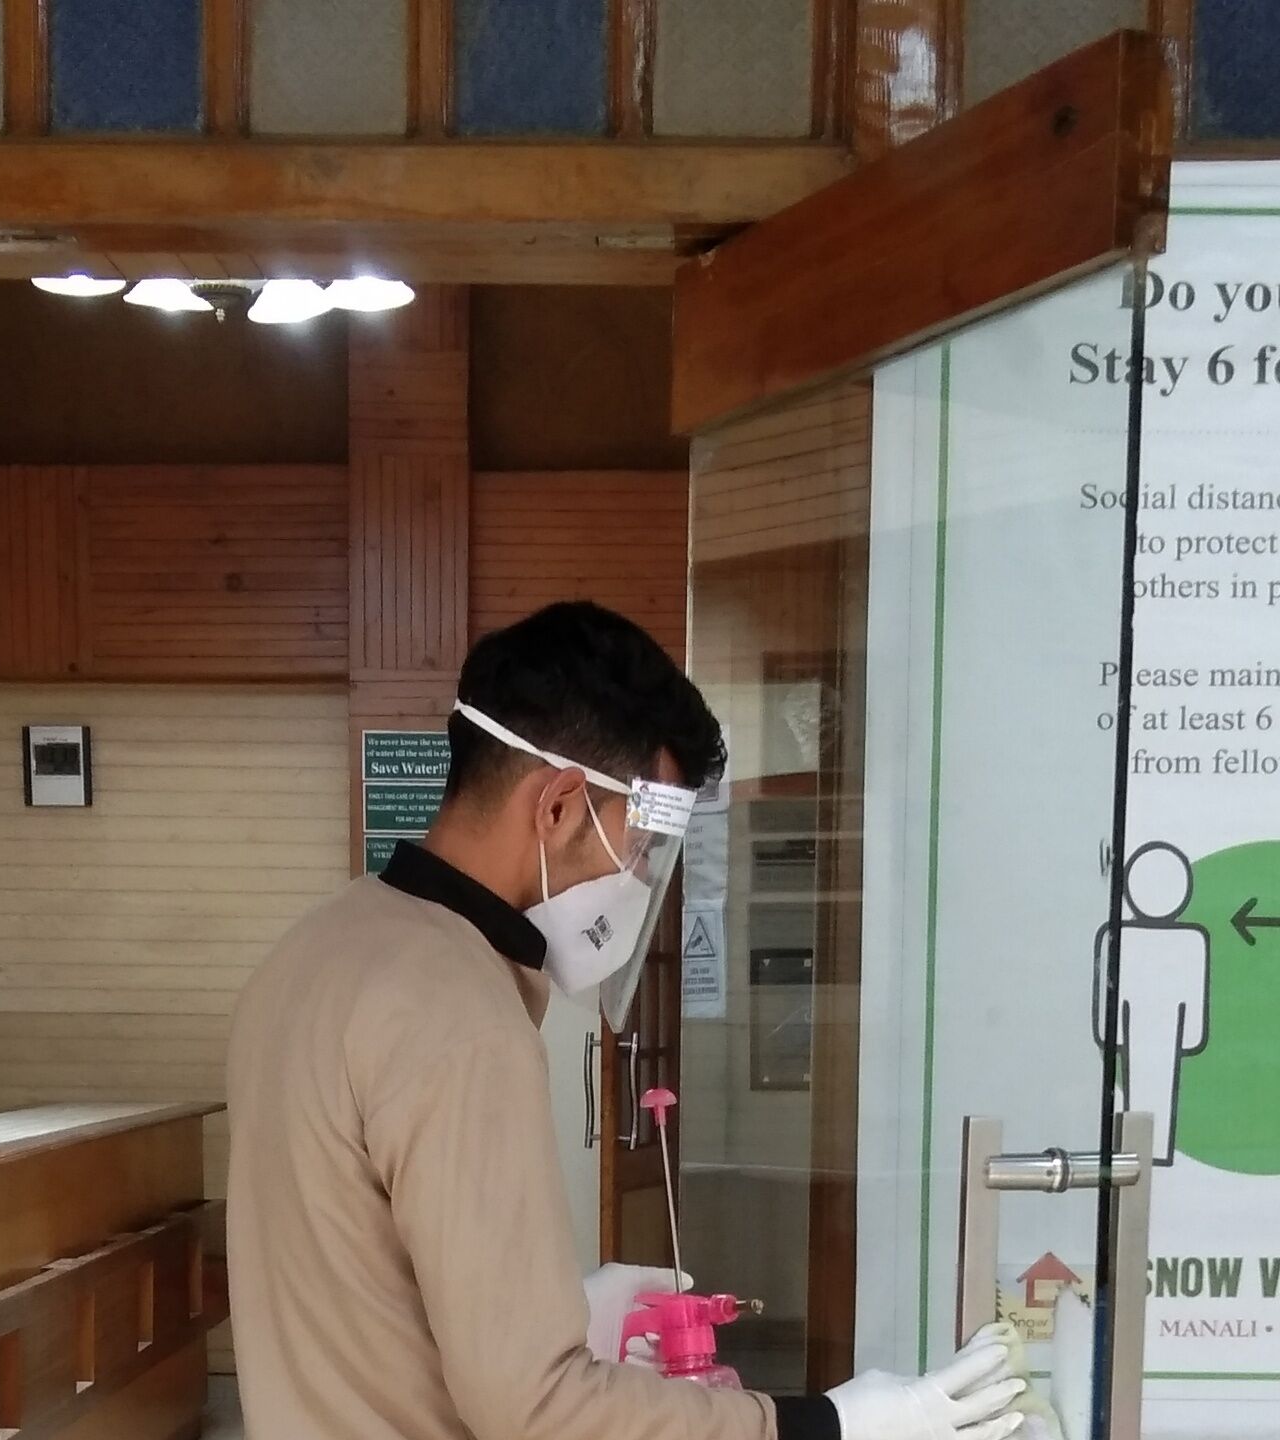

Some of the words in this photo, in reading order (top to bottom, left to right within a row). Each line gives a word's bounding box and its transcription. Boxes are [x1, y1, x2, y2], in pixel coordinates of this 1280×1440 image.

[1118, 271, 1196, 312] Do
[1069, 342, 1190, 397] Stay
[1207, 345, 1236, 386] 6
[1080, 483, 1176, 511] Social
[1137, 532, 1165, 555] to
[1176, 532, 1278, 563] protect
[1133, 573, 1220, 600] others
[1231, 573, 1258, 600] in
[1098, 661, 1200, 688] Pease
[1097, 704, 1136, 731] o
[1142, 710, 1169, 731] at
[1178, 705, 1246, 731] least
[1255, 704, 1273, 731] 6
[371, 761, 399, 774] Save
[1131, 748, 1202, 775] from
[1159, 1319, 1257, 1338] MANALI
